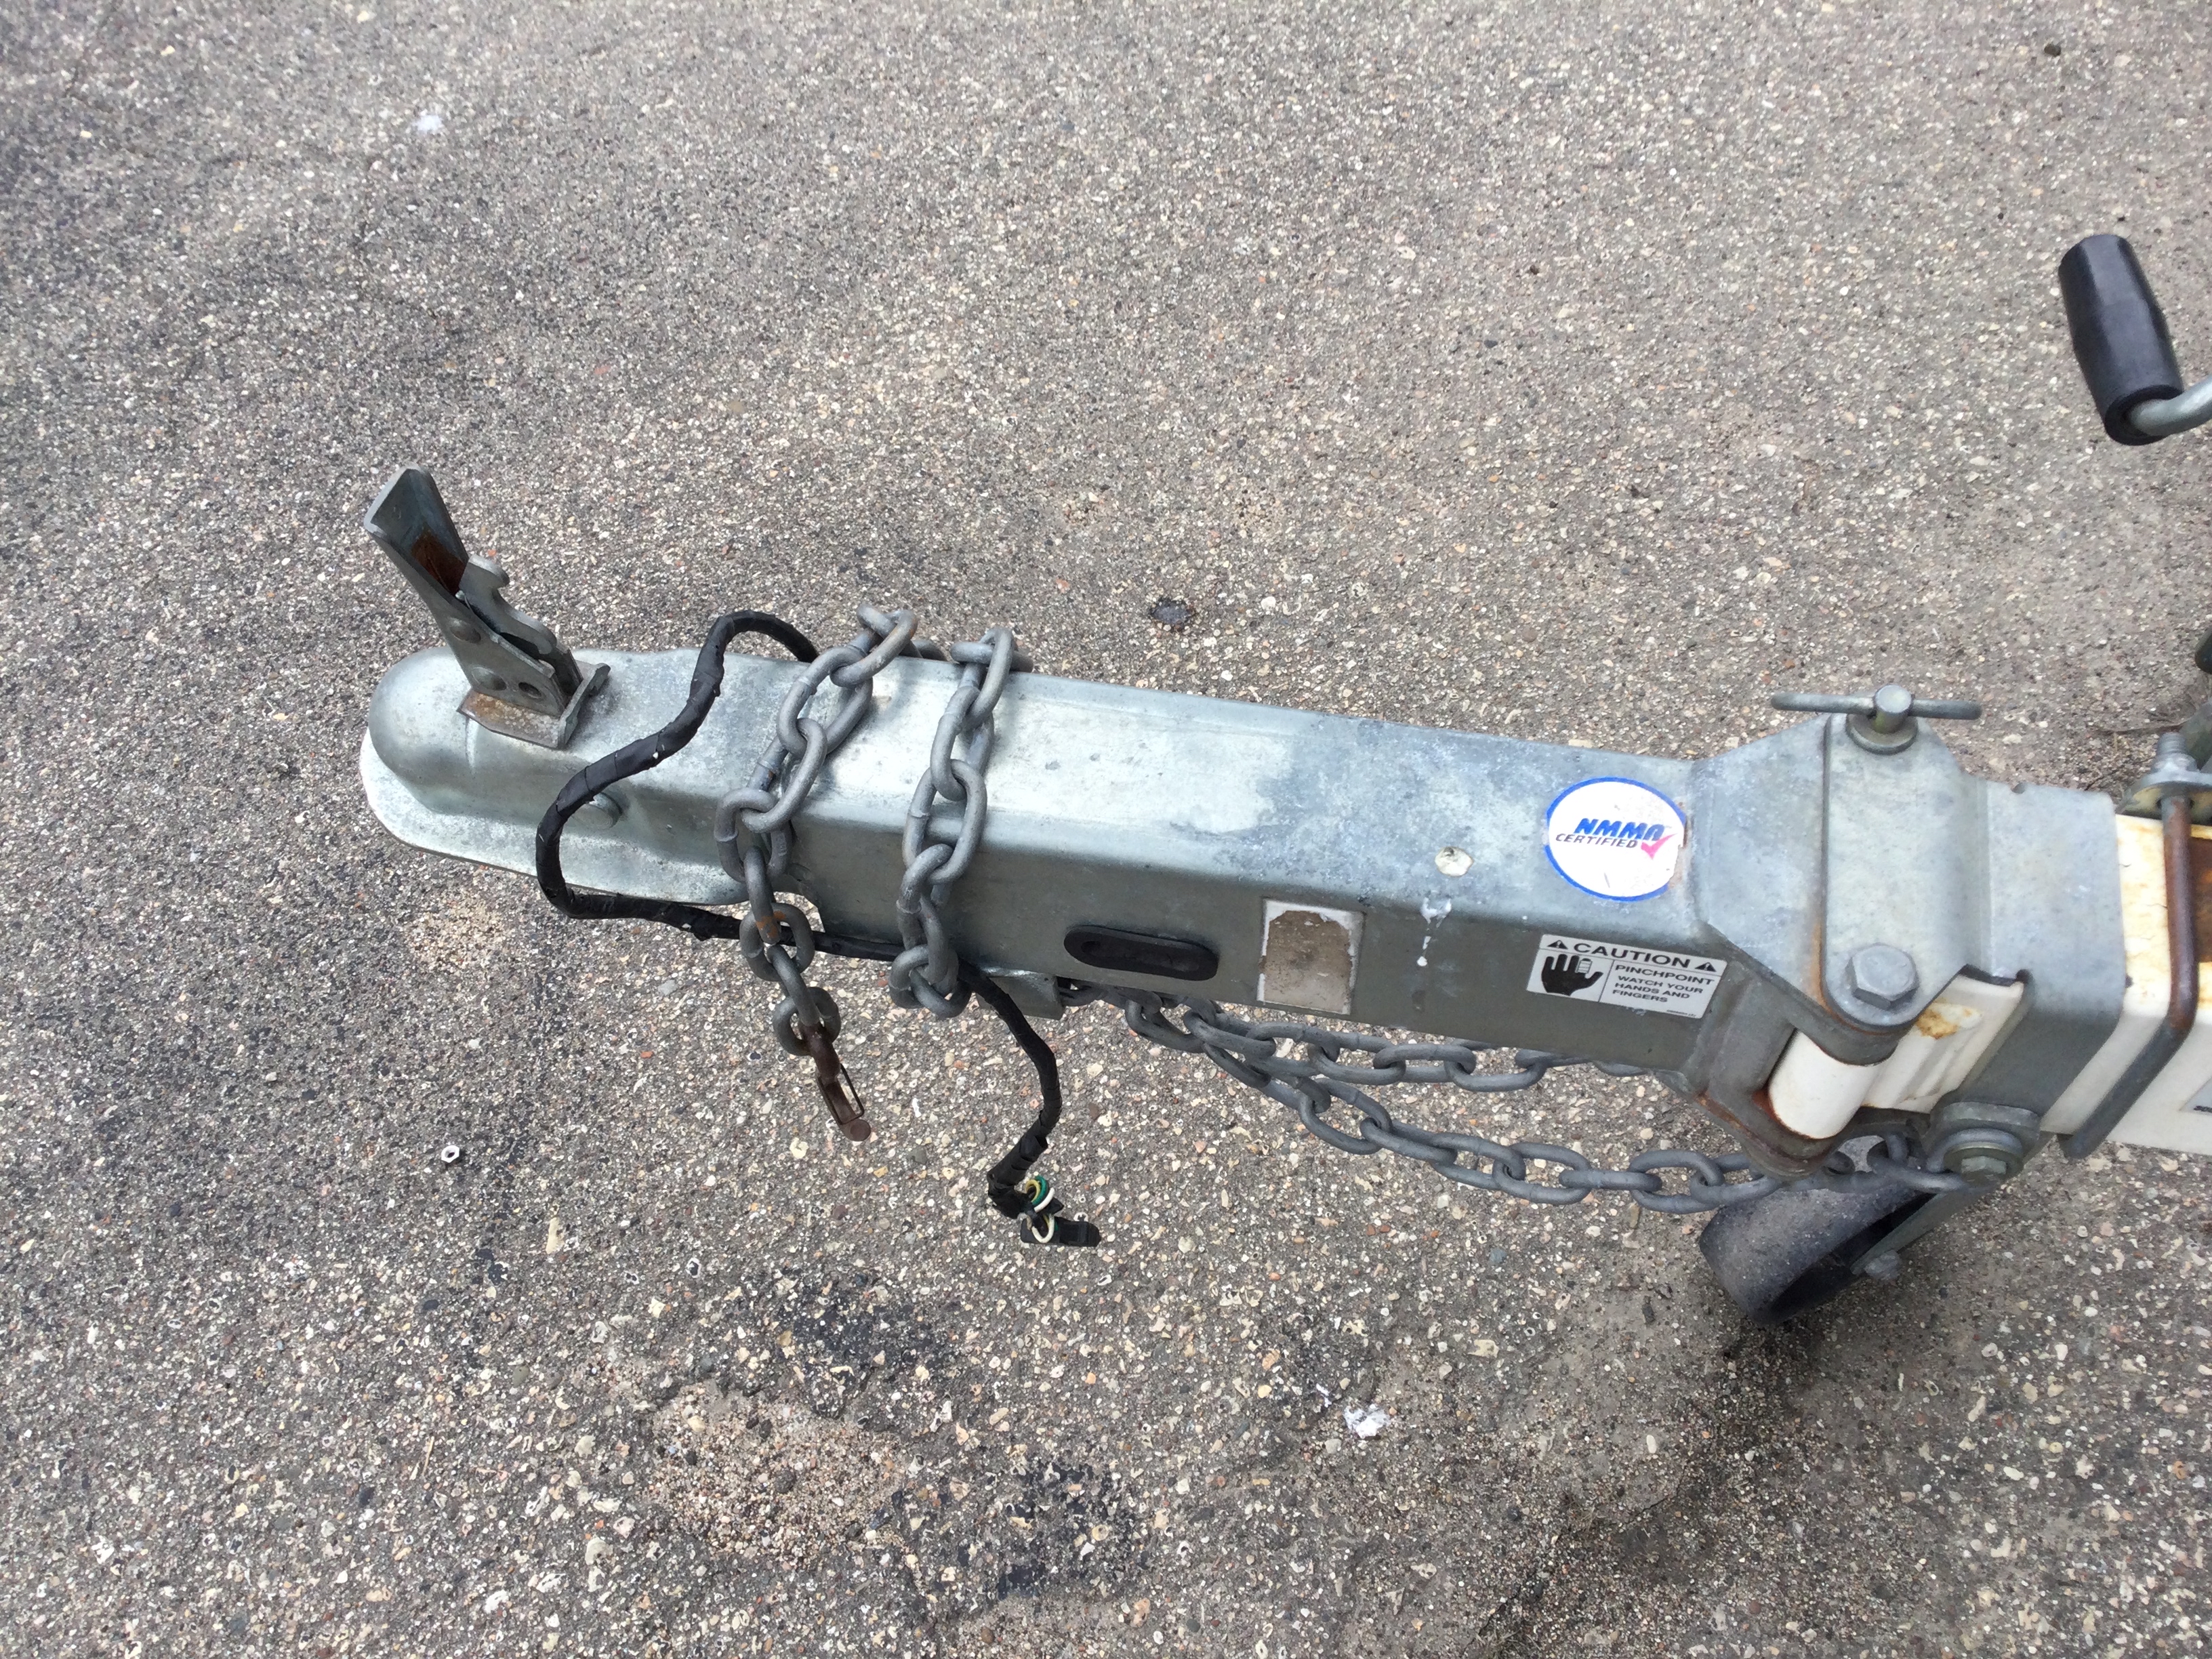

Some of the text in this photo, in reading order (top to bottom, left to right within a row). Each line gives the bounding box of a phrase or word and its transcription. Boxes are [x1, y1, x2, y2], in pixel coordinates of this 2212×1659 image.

[1574, 818, 1665, 841] NMMA
[1555, 834, 1639, 848] CERTIFIED
[1573, 943, 1691, 968] CAUTION
[1615, 964, 1715, 985] PINCHPOINT
[1614, 983, 1690, 999] HANDS AND
[1618, 975, 1704, 994] WATCH YOUR
[1612, 989, 1668, 1002] FINGERS
